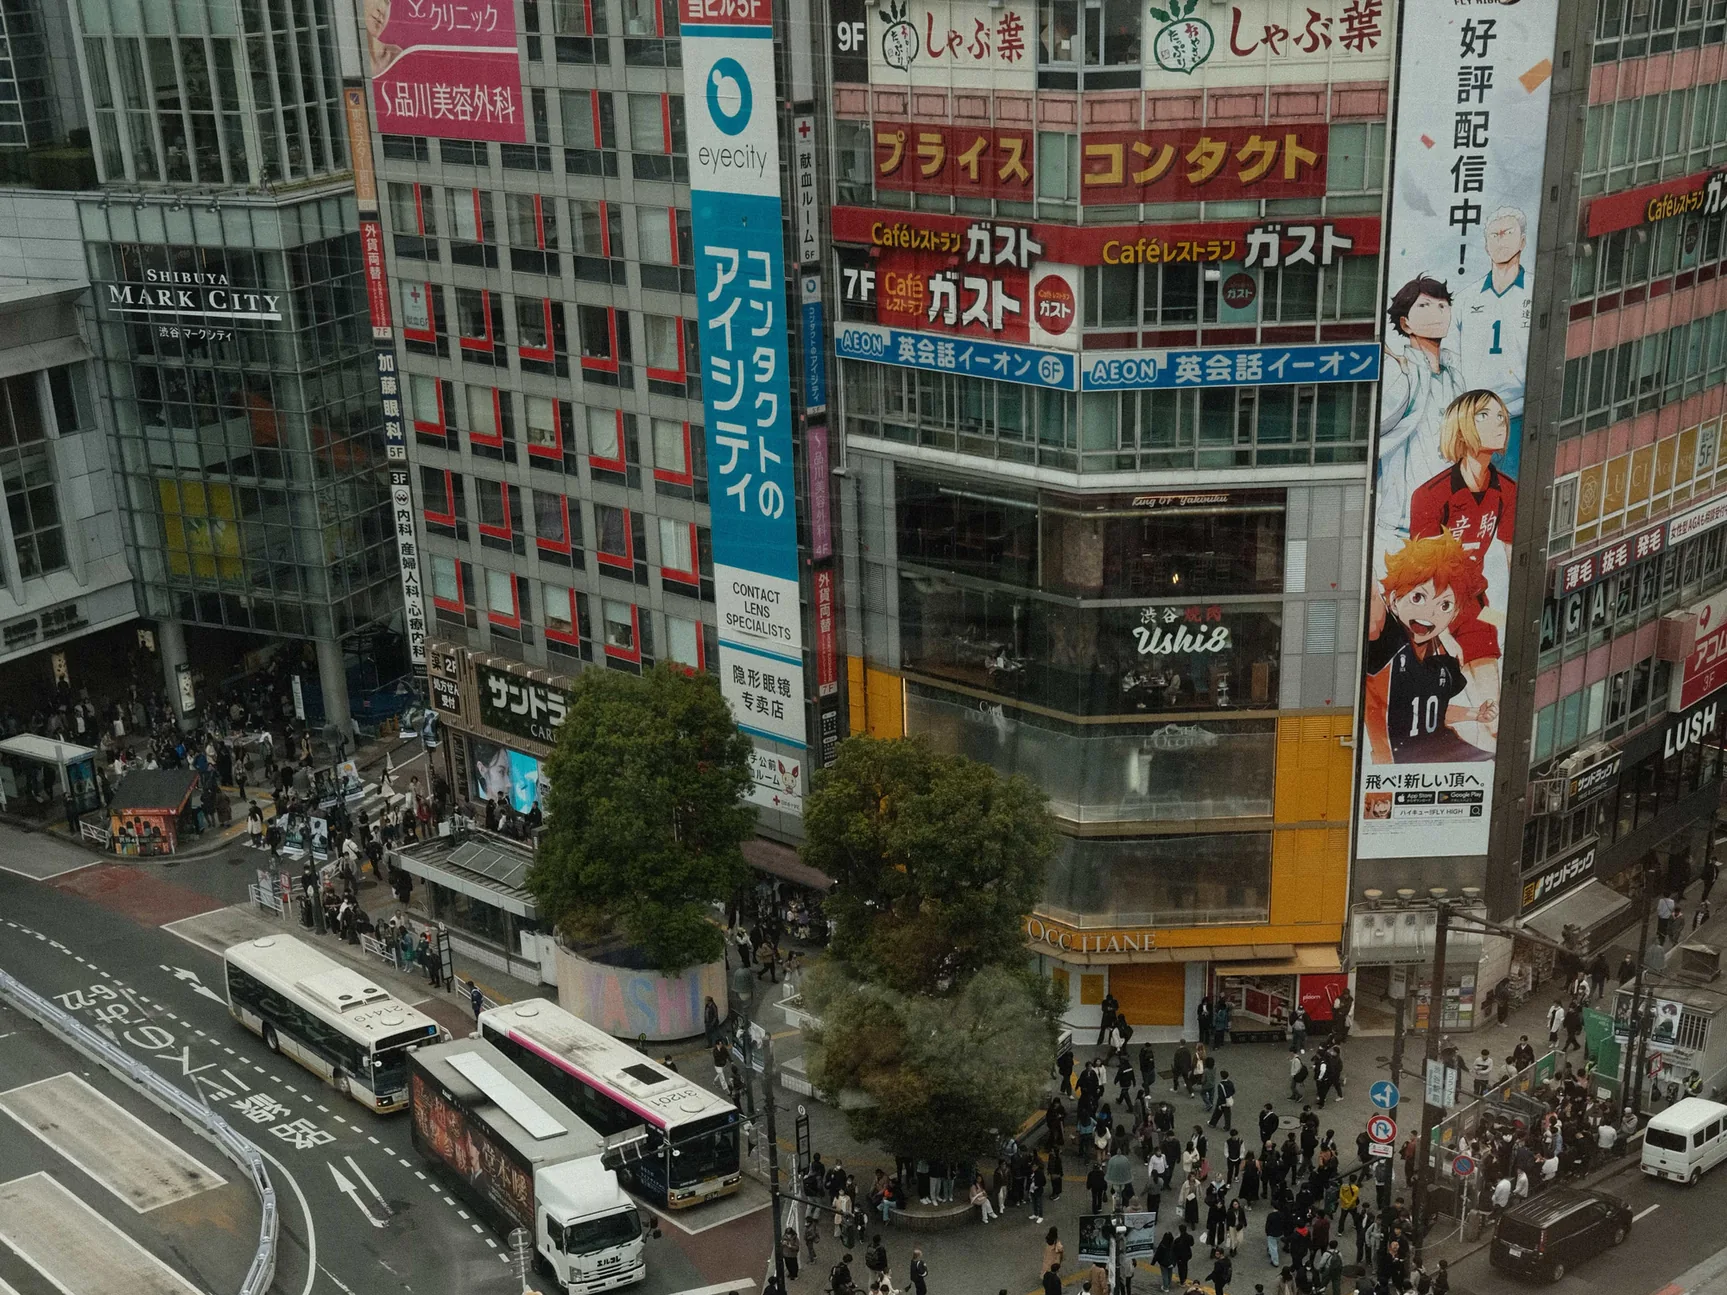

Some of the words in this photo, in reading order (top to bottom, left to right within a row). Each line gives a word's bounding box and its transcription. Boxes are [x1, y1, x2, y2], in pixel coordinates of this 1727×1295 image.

[429, 3, 498, 32] クリニック
[1229, 0, 1383, 57] しゃぶ葉
[837, 21, 865, 51] 9F
[926, 11, 1025, 63] しゃぶ葉
[394, 81, 516, 124] 品川美容外科
[698, 144, 768, 178] eyecity
[876, 129, 1030, 183] プライス
[1084, 133, 1318, 185] コンタクト
[799, 152, 815, 244] 献血ルーム
[364, 223, 381, 280] 外貨両替
[804, 249, 816, 260] 6F
[966, 222, 1042, 269] ガスト
[1244, 224, 1352, 269] ガスト
[146, 268, 229, 286] SHIBUYA
[843, 268, 876, 301] 7F
[884, 272, 924, 299] Café
[107, 284, 196, 309] MARK
[208, 290, 281, 313] CITY
[885, 299, 924, 317] レストラン
[928, 271, 1021, 331] ガスト
[1039, 301, 1072, 319] ガスト
[375, 327, 388, 337] 7F
[842, 330, 884, 355] AEON
[1488, 319, 1503, 355] 1
[898, 335, 1032, 377] 英会話イーオン
[1041, 359, 1063, 380] 6F
[1091, 358, 1158, 383] AEON
[1175, 350, 1373, 384] 英会話イーオン
[703, 244, 753, 513] アイシティ
[746, 248, 785, 520] コンタクトの
[377, 353, 403, 441] 加藤眼科
[389, 446, 404, 458] 5F
[1698, 444, 1712, 467] 5F
[391, 473, 407, 485] 3F
[397, 508, 413, 537] 内科
[815, 543, 829, 555] 4F
[1601, 543, 1628, 575] 抜毛
[1636, 528, 1661, 559] 発毛
[1565, 558, 1593, 590] 薄毛
[732, 581, 781, 604] CONTACT
[818, 571, 831, 634] 外貨両替
[744, 600, 771, 619] LENS
[1140, 606, 1179, 624] 渋谷
[1539, 582, 1605, 647] AGA
[726, 612, 792, 641] SPECIALISTS
[1132, 624, 1229, 655] Ushi8
[732, 663, 792, 699] 隐形眼镜
[822, 684, 835, 695] 7F
[1702, 671, 1716, 692] 3F
[488, 674, 571, 727] サンドラ
[741, 690, 785, 721] 专卖店
[1409, 694, 1439, 737] 10
[1663, 701, 1718, 760] LUSH
[1544, 848, 1596, 893] サンドラッグ
